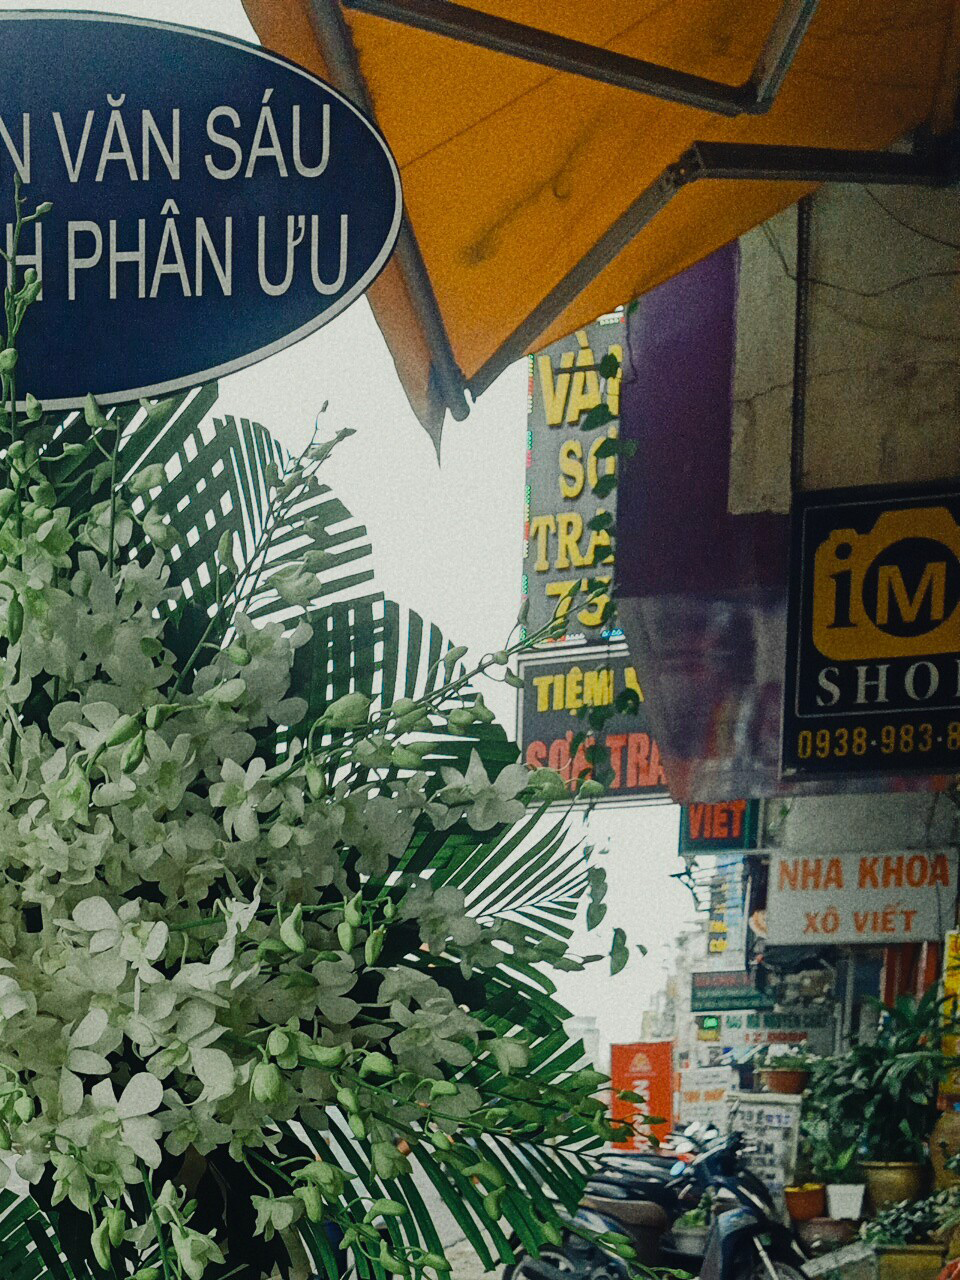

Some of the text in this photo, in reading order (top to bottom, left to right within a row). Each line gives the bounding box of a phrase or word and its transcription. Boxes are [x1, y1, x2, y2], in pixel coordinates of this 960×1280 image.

[52, 94, 181, 184] VĂN
[203, 88, 331, 180] SÁU
[66, 199, 233, 303] PHÂN
[258, 214, 349, 298] ƯU
[532, 666, 615, 716] TIỆM
[815, 658, 960, 707] SHO
[778, 853, 950, 892] NHA KHOA
[803, 901, 918, 935] XÔ VIẾT
